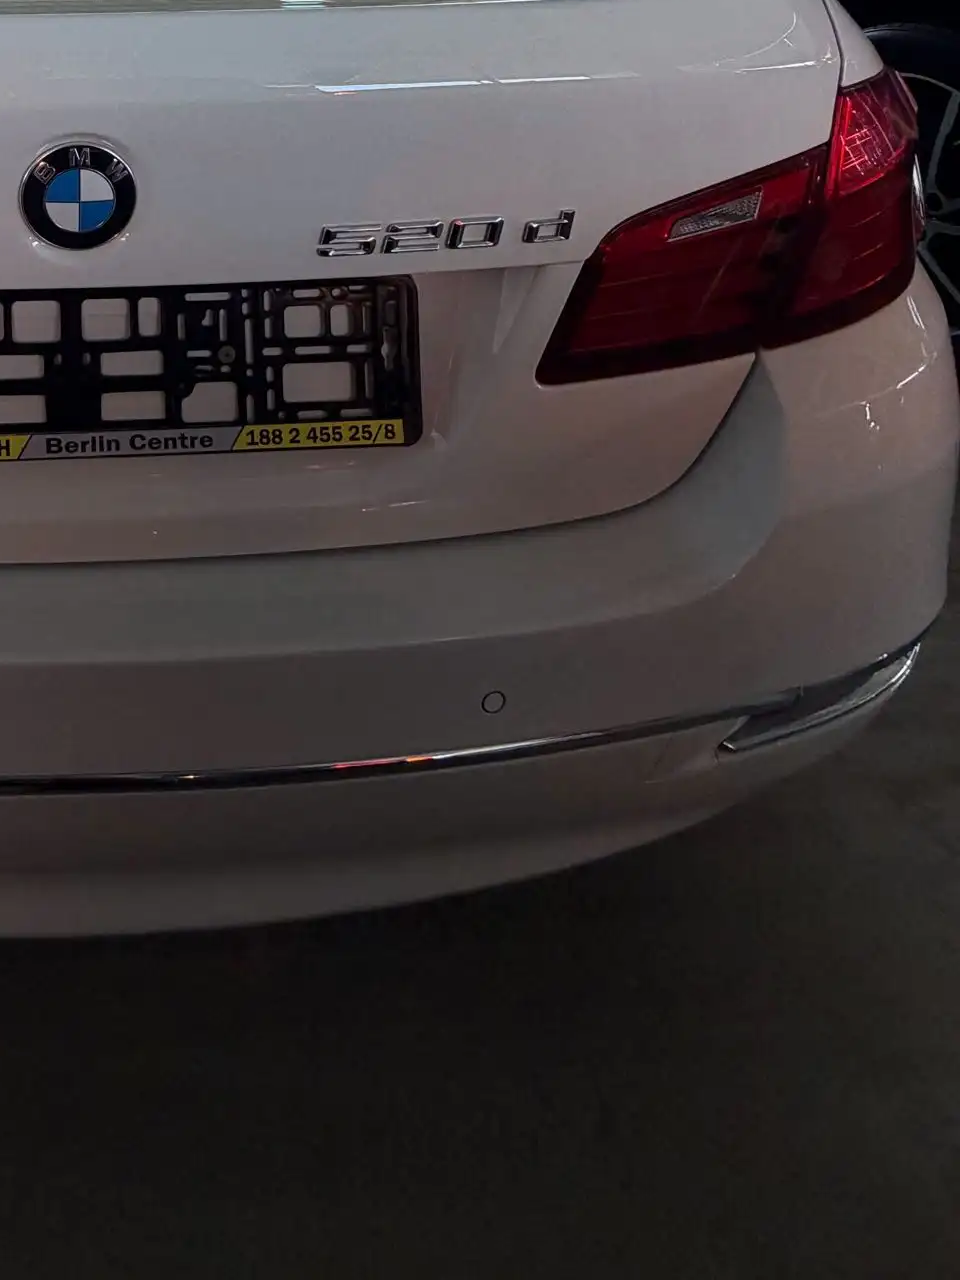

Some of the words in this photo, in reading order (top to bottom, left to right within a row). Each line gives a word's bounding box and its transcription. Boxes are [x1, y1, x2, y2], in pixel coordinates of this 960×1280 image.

[33, 147, 129, 185] BMW
[316, 216, 505, 257] 520
[45, 434, 121, 454] Berlin
[129, 431, 214, 452] Centre
[245, 428, 284, 447] 188
[288, 427, 301, 444] 2
[305, 425, 343, 444] 455
[348, 423, 396, 444] 25/8
